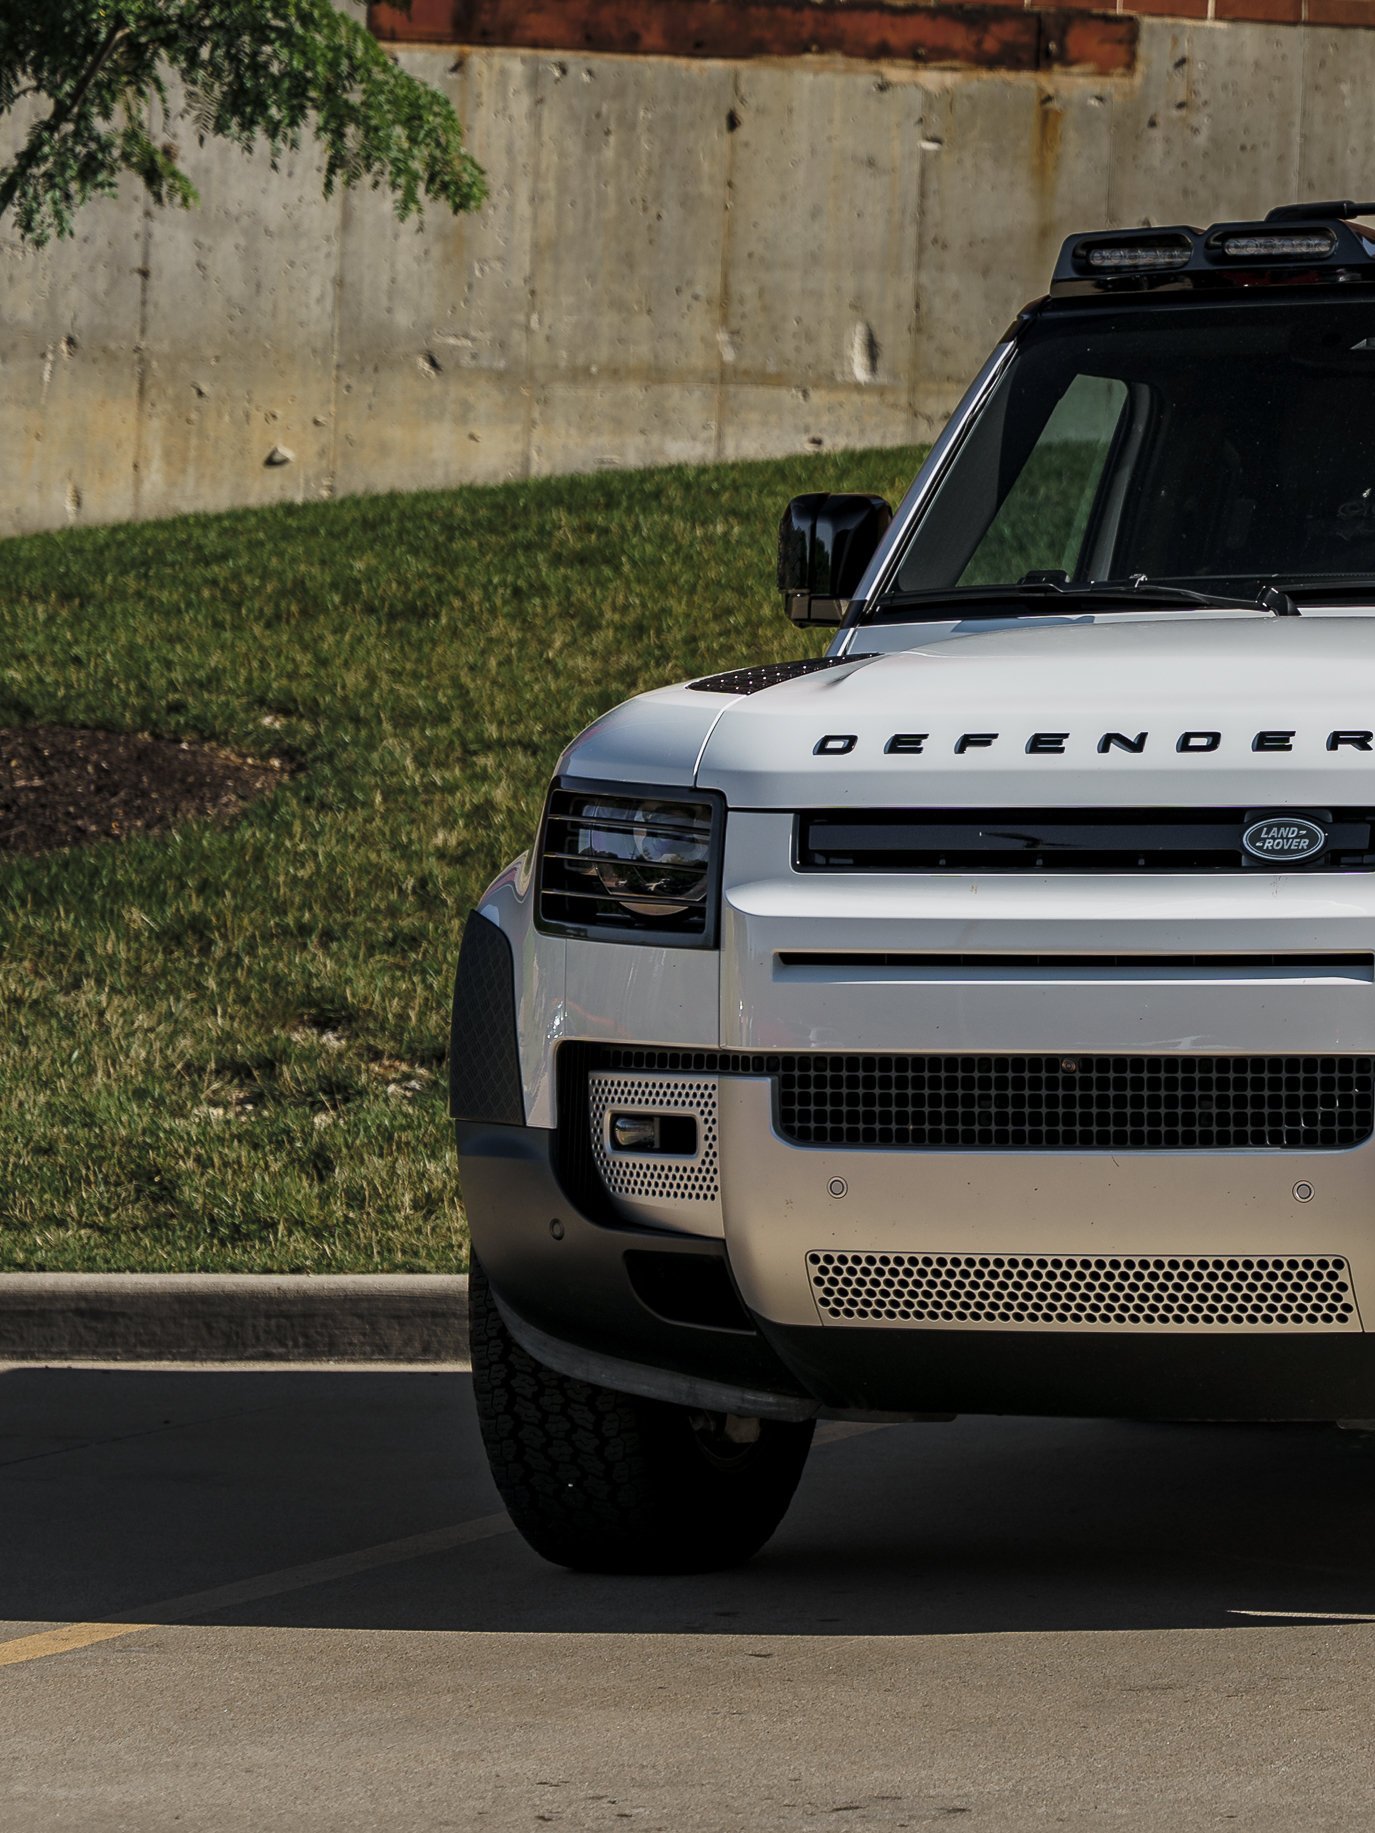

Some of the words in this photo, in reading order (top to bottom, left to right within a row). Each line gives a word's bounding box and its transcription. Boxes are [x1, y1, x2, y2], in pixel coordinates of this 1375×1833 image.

[813, 730, 1374, 756] DEFENDER
[1261, 827, 1299, 838] LAND
[1263, 839, 1310, 850] ROVER
